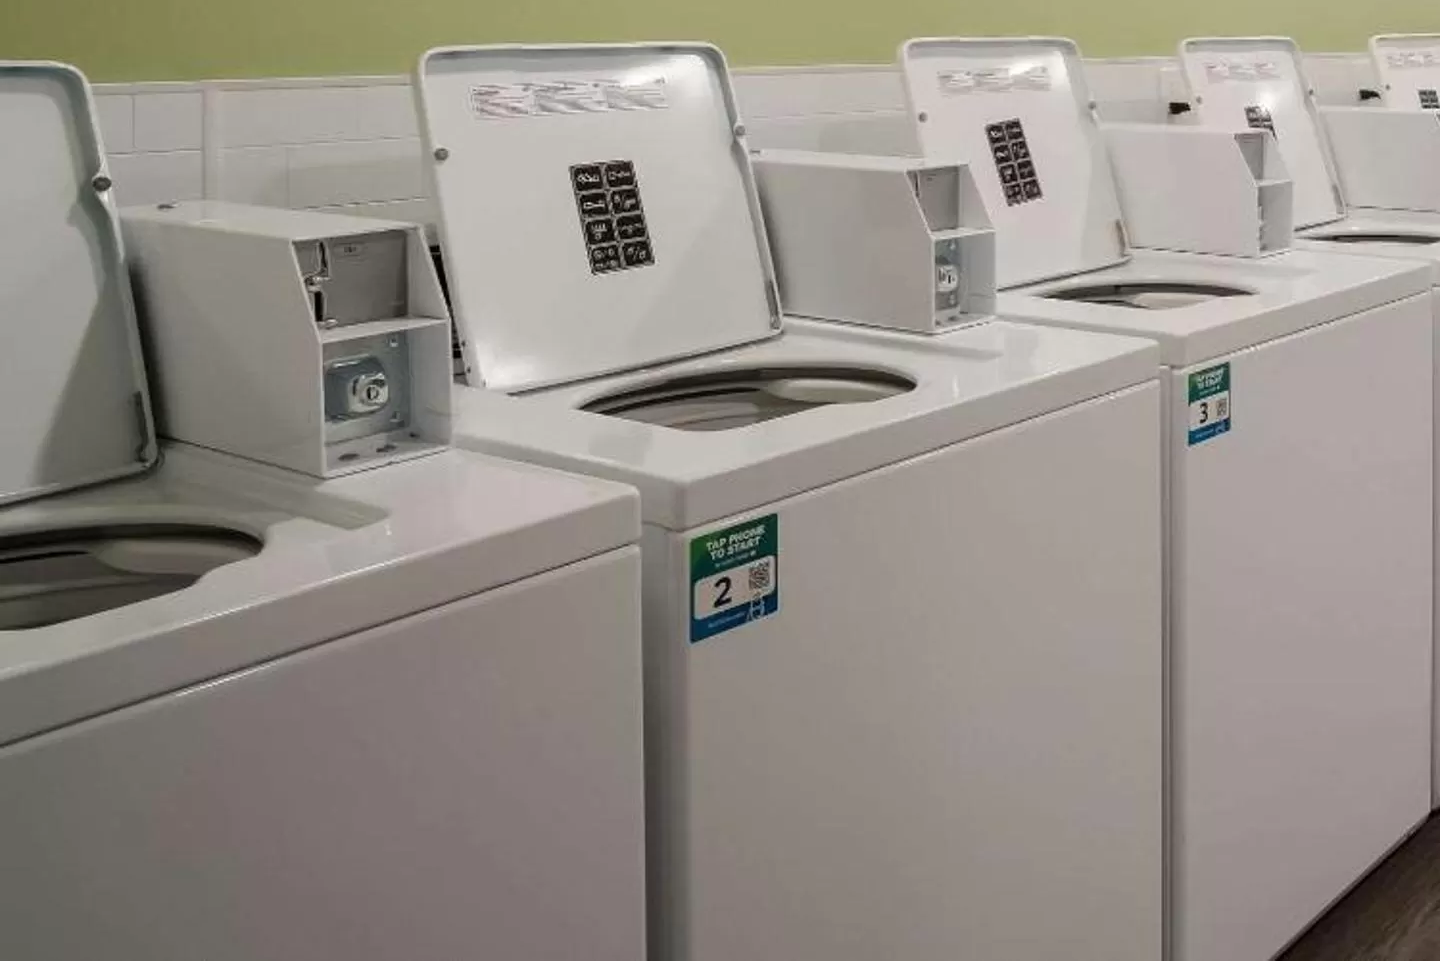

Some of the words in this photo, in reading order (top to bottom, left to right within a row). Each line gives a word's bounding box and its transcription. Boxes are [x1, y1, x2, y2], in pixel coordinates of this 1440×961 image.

[1199, 402, 1209, 424] 3
[706, 537, 727, 551] TAP
[728, 525, 766, 544] PHONE
[710, 549, 725, 561] TO
[727, 536, 761, 555] START
[713, 576, 733, 608] 2
